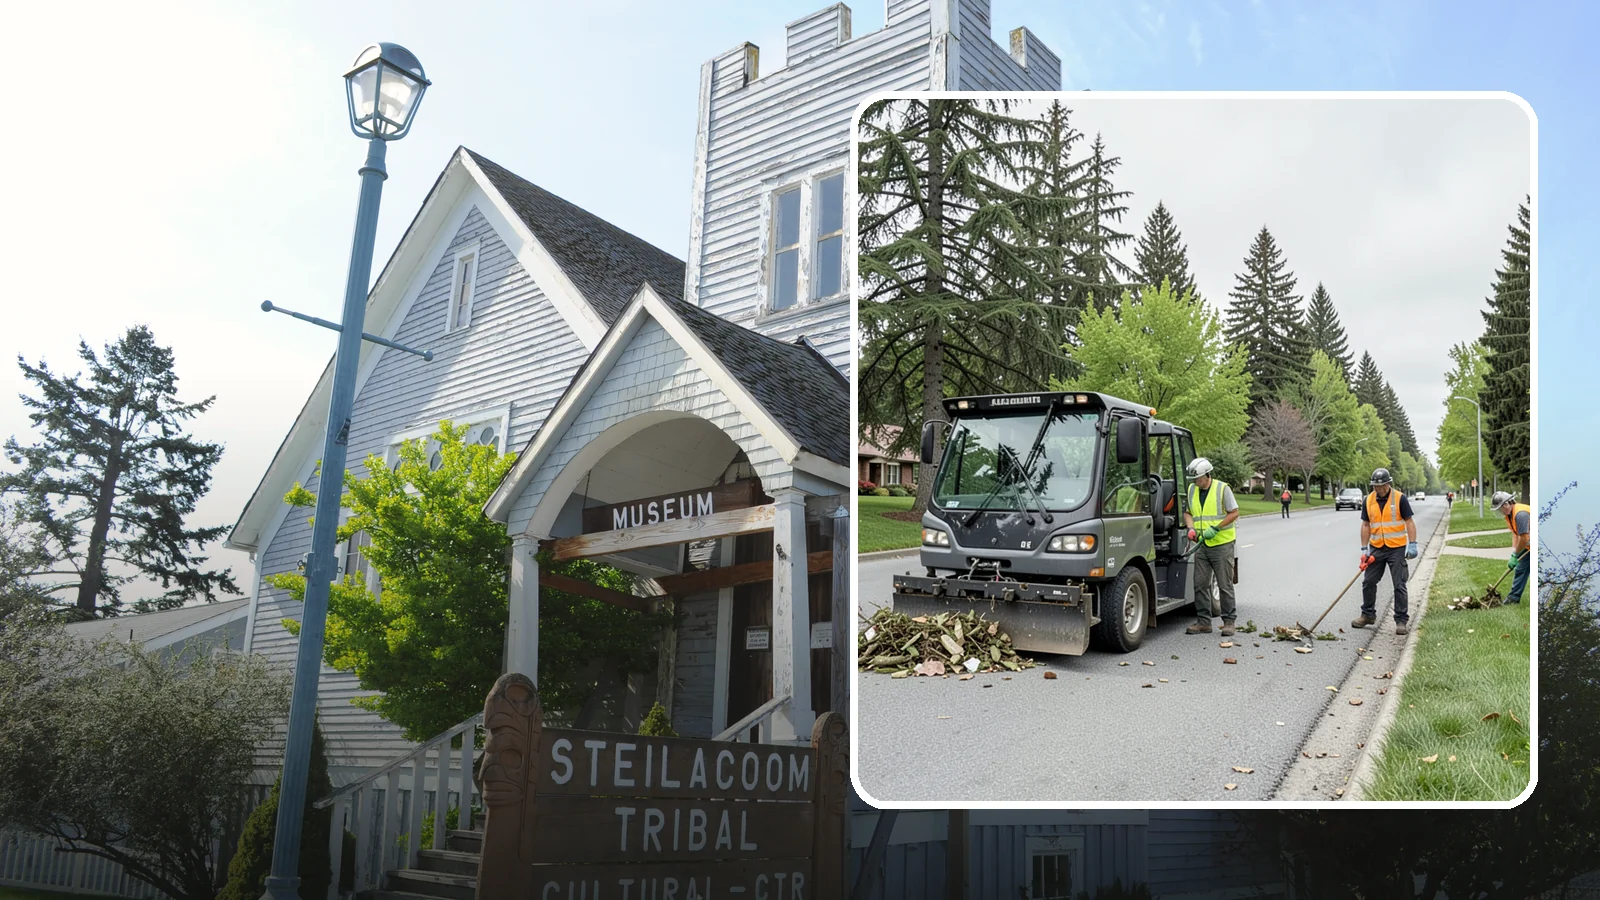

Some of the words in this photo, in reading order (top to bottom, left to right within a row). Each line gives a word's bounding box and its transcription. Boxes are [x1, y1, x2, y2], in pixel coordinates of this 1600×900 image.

[612, 491, 714, 531] MUSEUM
[550, 738, 810, 793] STEILACOOM
[614, 806, 758, 852] TRIBAL
